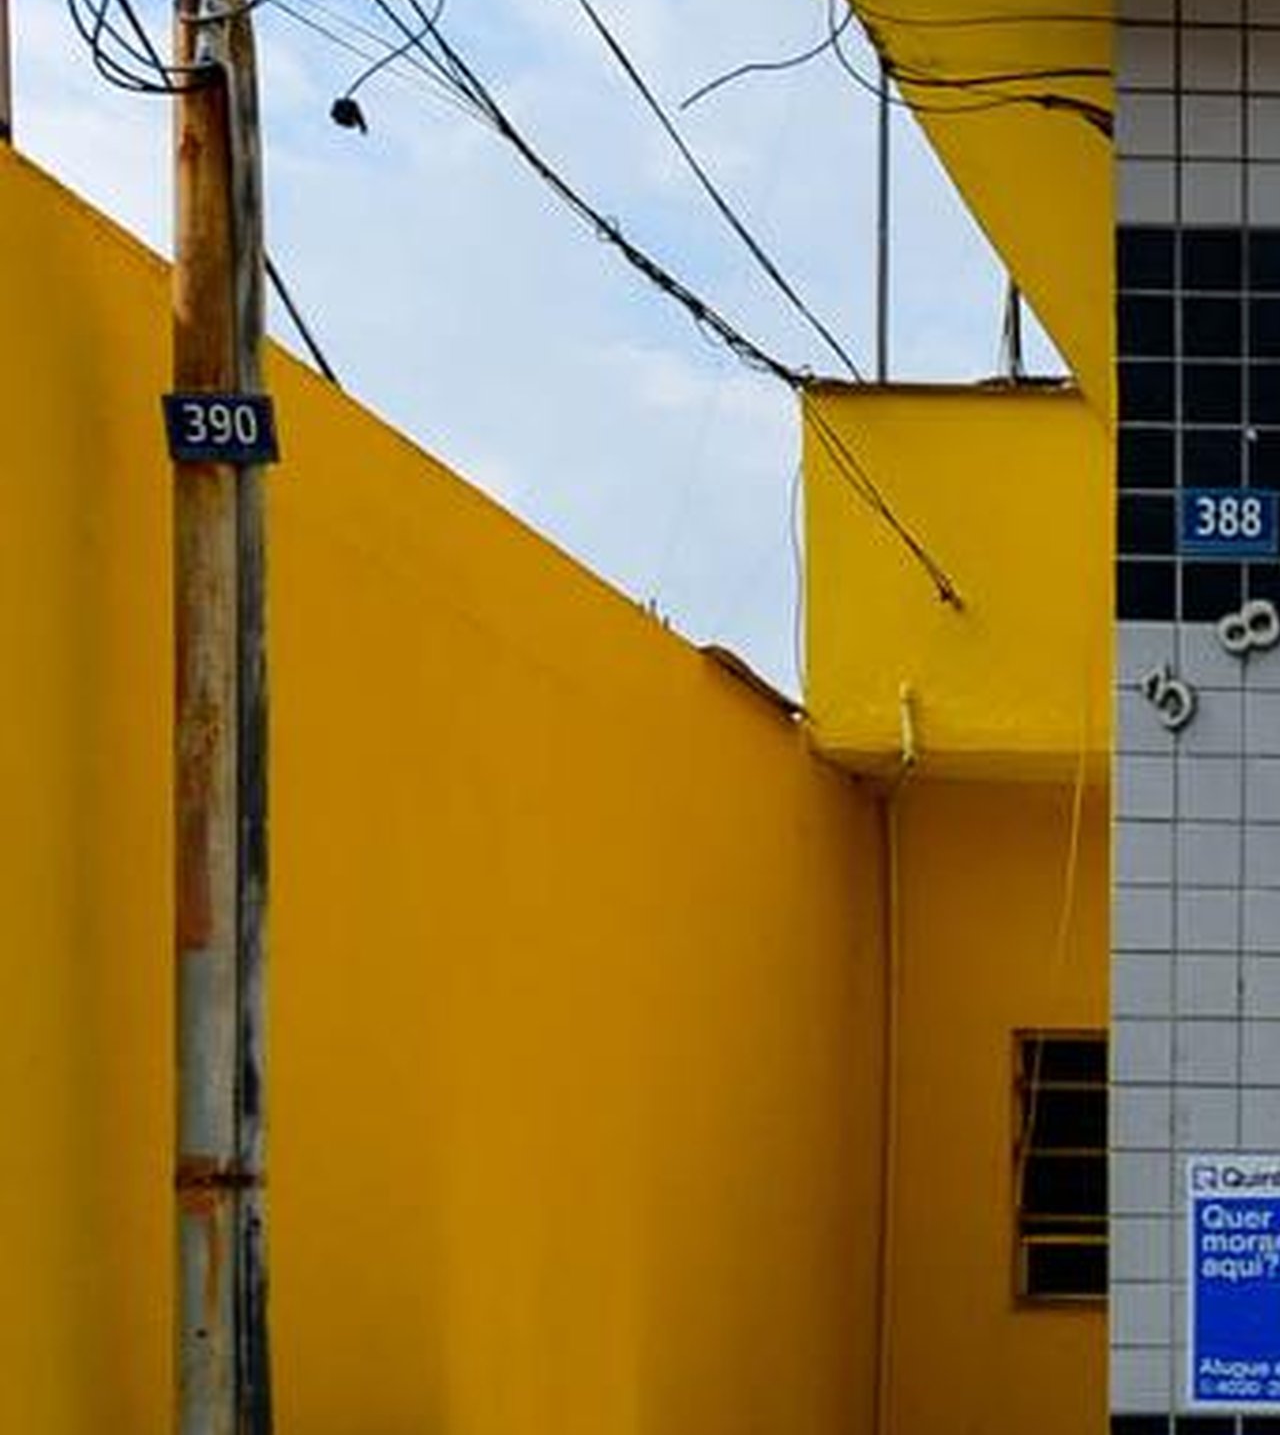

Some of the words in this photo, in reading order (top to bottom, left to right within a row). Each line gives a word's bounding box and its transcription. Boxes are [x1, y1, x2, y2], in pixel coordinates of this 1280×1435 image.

[182, 403, 258, 444] 390
[1196, 497, 1262, 537] 388
[1202, 1203, 1273, 1230] Quer
[1202, 1253, 1280, 1280] aqui?
